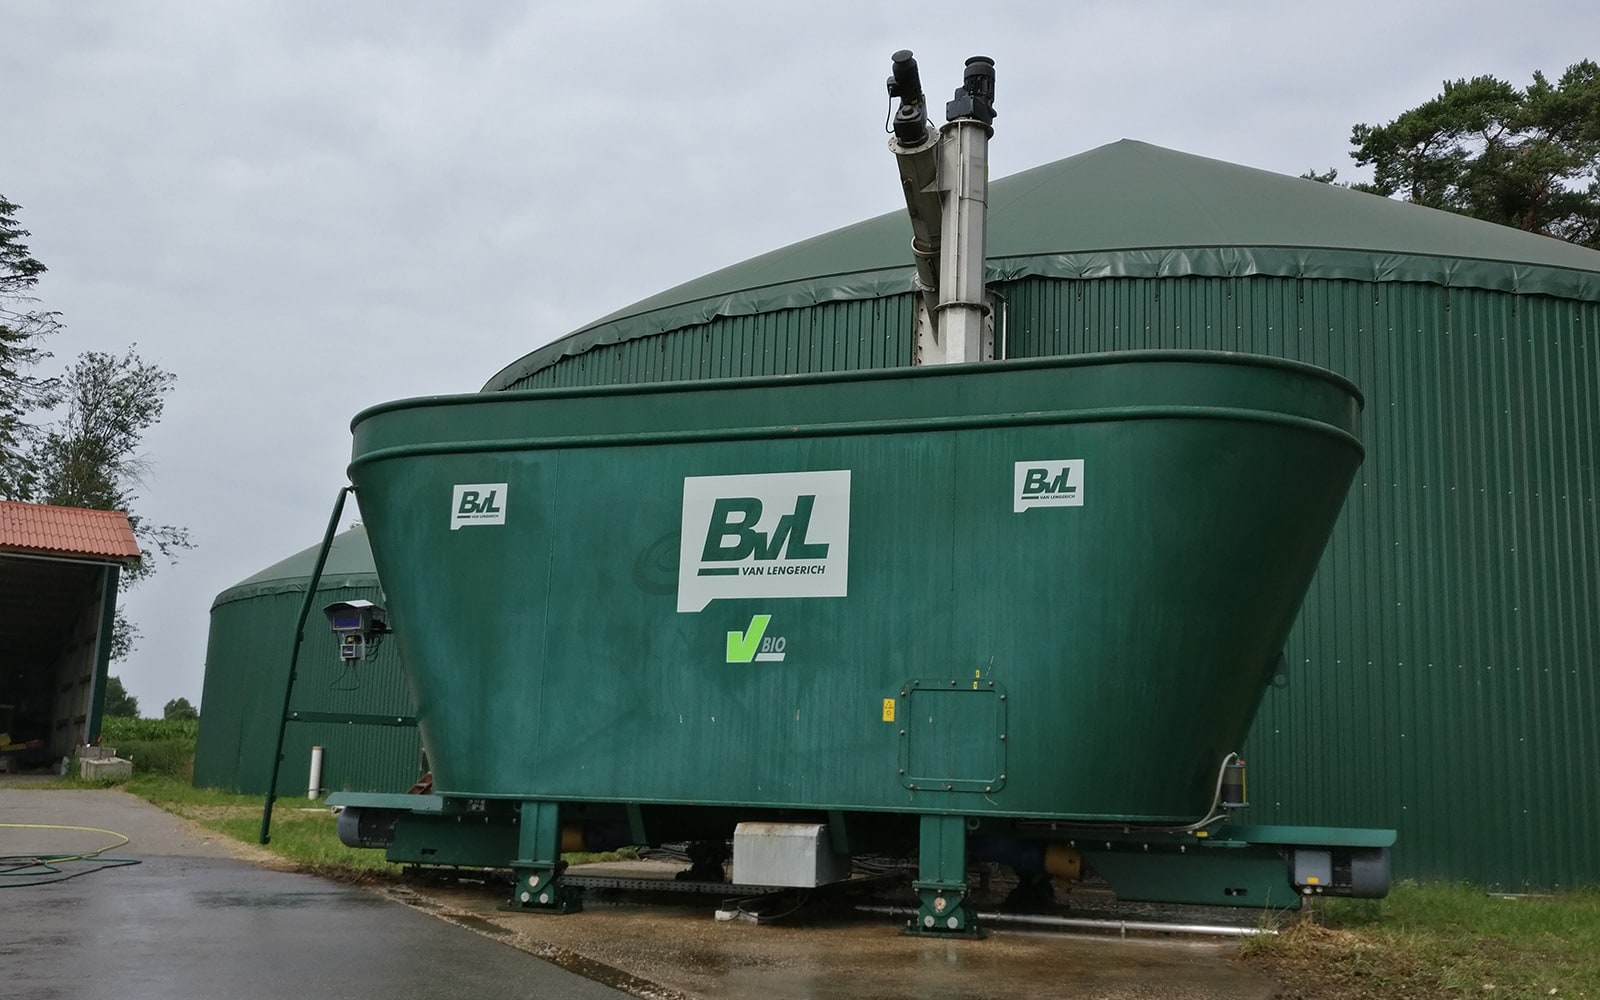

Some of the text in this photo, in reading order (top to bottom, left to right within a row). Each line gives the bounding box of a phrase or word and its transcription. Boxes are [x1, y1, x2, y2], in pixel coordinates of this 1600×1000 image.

[1022, 467, 1077, 494] BvL
[701, 494, 830, 562] BvL
[742, 565, 826, 576] VAN LENGERICH
[761, 636, 786, 653] BIO
